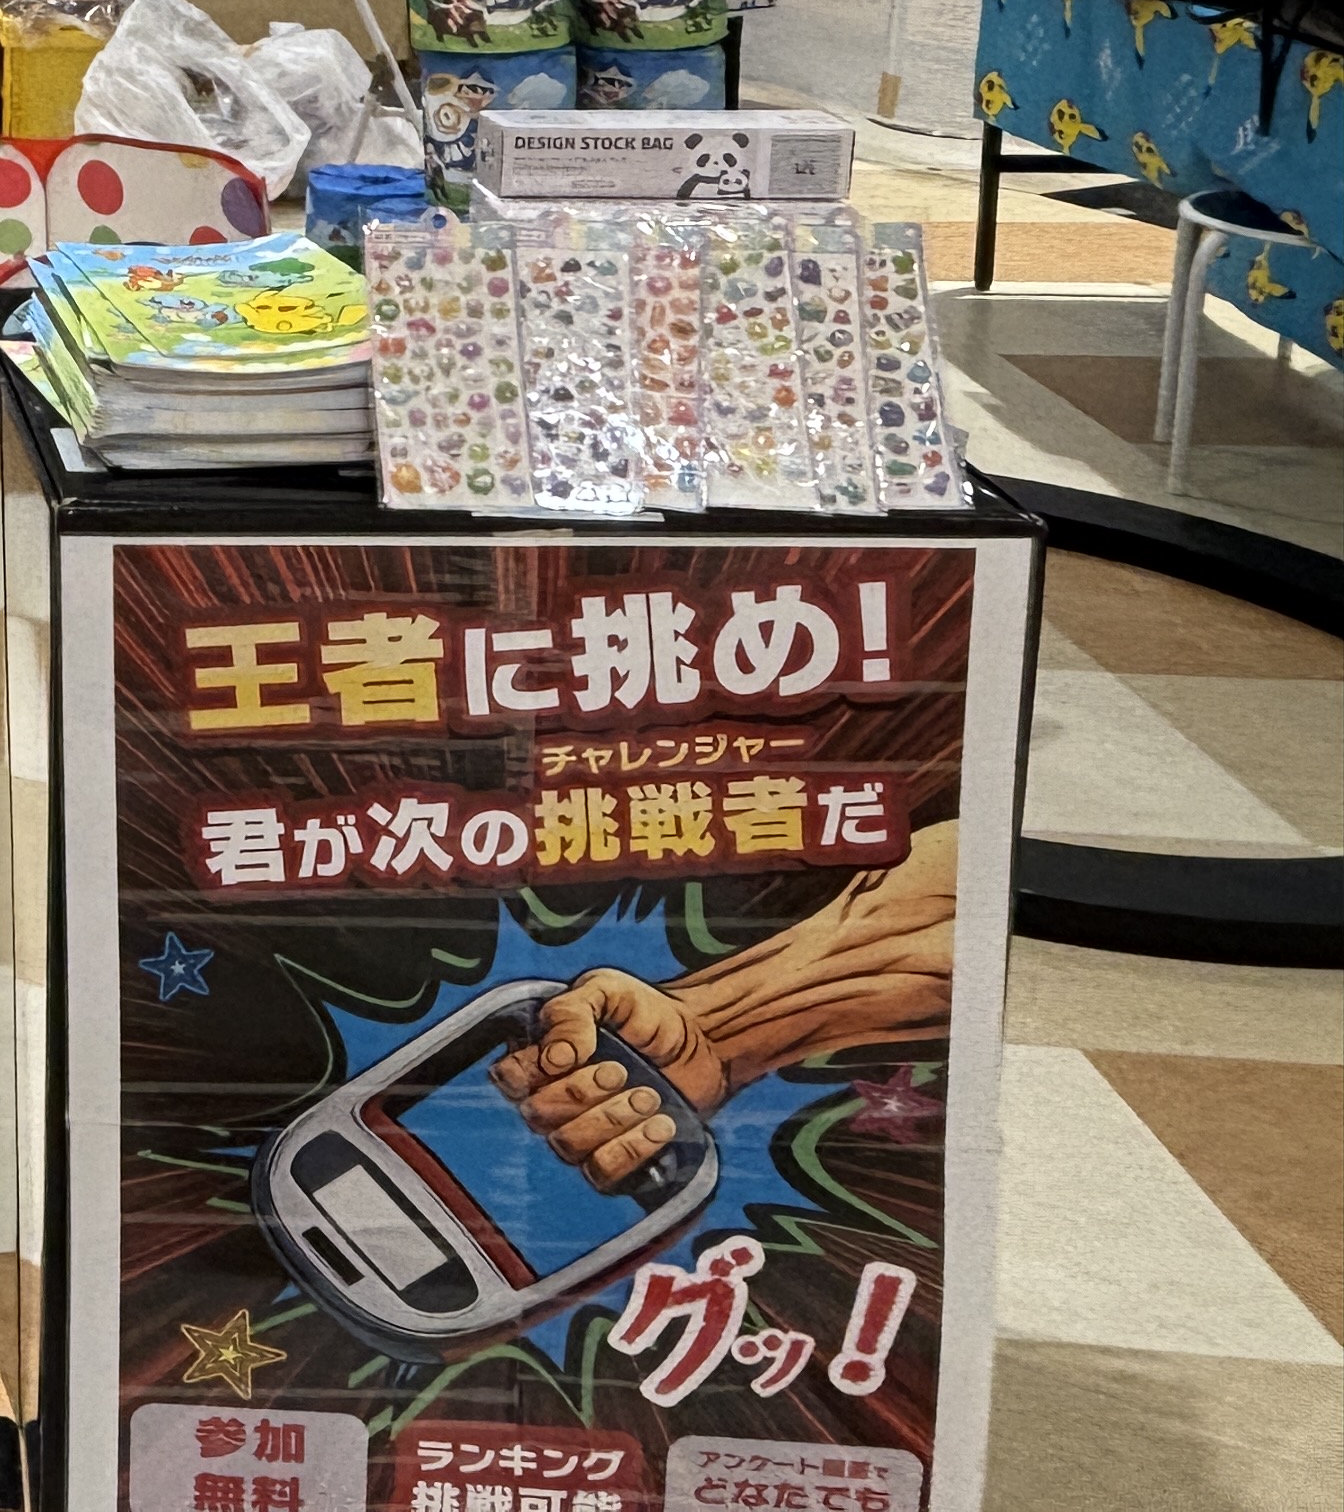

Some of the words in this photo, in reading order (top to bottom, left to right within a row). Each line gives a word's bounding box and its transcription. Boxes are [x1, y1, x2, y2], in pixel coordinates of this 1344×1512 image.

[514, 136, 576, 150] DESIGN
[580, 136, 637, 150] STOCK
[641, 136, 674, 150] BAG
[185, 582, 892, 731] 王者に挑め！
[542, 733, 805, 777] チャレンジャー
[200, 774, 889, 886] 君が次の挑戦者だ
[608, 1235, 917, 1407] グッ！
[195, 1416, 306, 1464] 参加
[418, 1439, 626, 1482] ランキング
[693, 1476, 891, 1512] どなたでも
